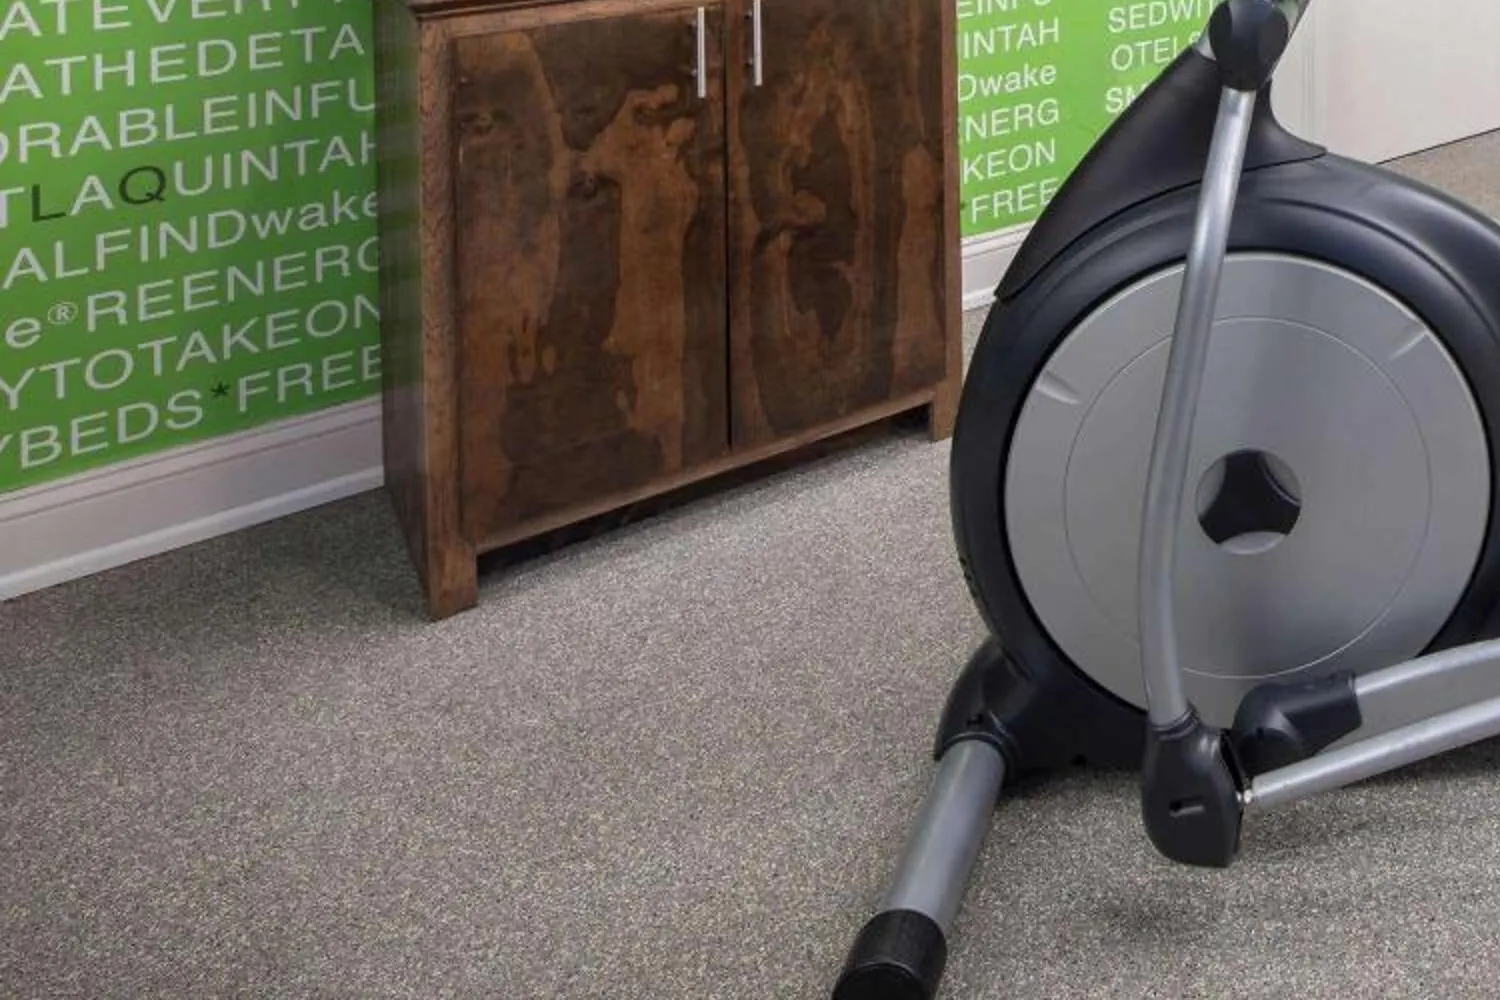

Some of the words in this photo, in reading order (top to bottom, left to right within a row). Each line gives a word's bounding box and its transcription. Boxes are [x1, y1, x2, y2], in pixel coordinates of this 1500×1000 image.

[1, 23, 366, 100] ATHEDETA
[0, 78, 375, 165] RABLEINFU
[0, 342, 383, 469] BEDSFREE
